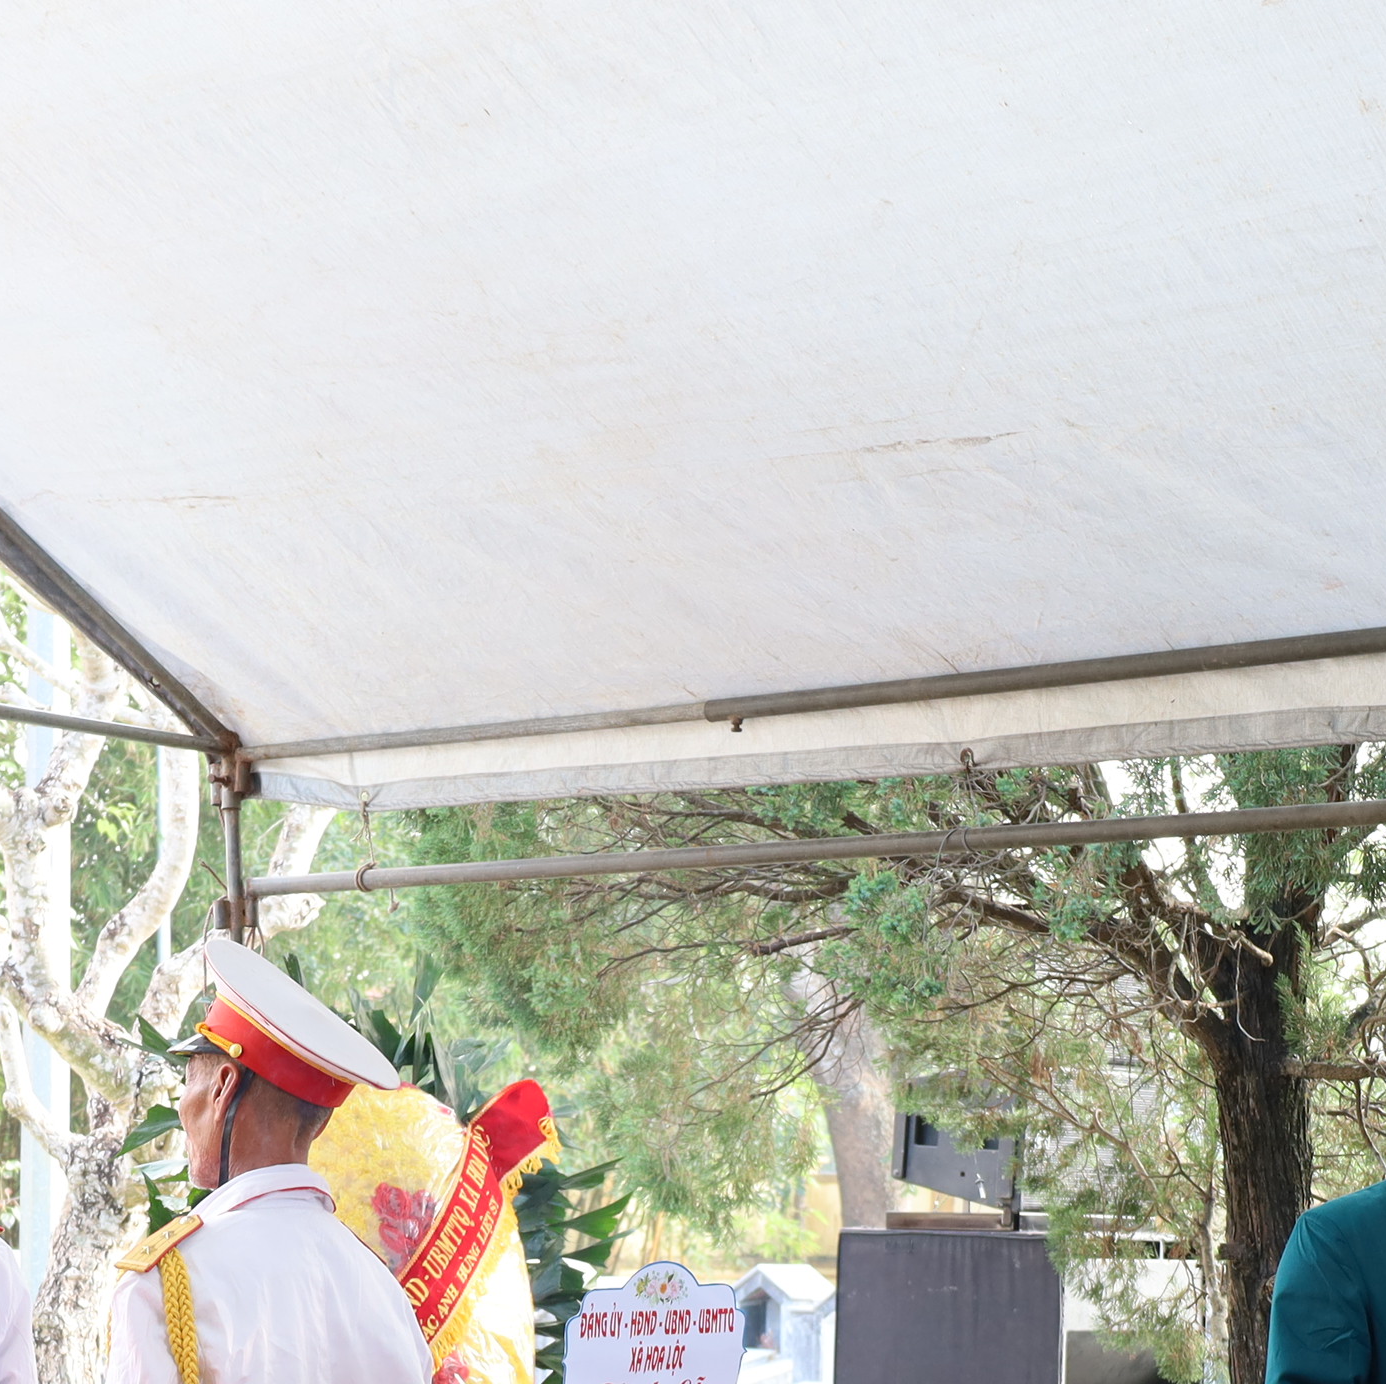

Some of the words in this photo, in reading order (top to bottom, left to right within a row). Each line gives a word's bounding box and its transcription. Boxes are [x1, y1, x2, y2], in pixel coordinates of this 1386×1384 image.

[404, 1278, 429, 1313] ND
[422, 1206, 475, 1279] UBMTTQ
[420, 1315, 439, 1340] ÁC
[438, 1283, 459, 1318] ANH
[580, 1303, 607, 1341] ĐẢNG
[609, 1302, 624, 1340] ỦY
[629, 1310, 658, 1340] HĐND
[664, 1309, 691, 1335] UBND
[698, 1307, 735, 1334] UBMTTQ
[643, 1346, 666, 1374] HOA
[665, 1339, 686, 1376] LỘC
